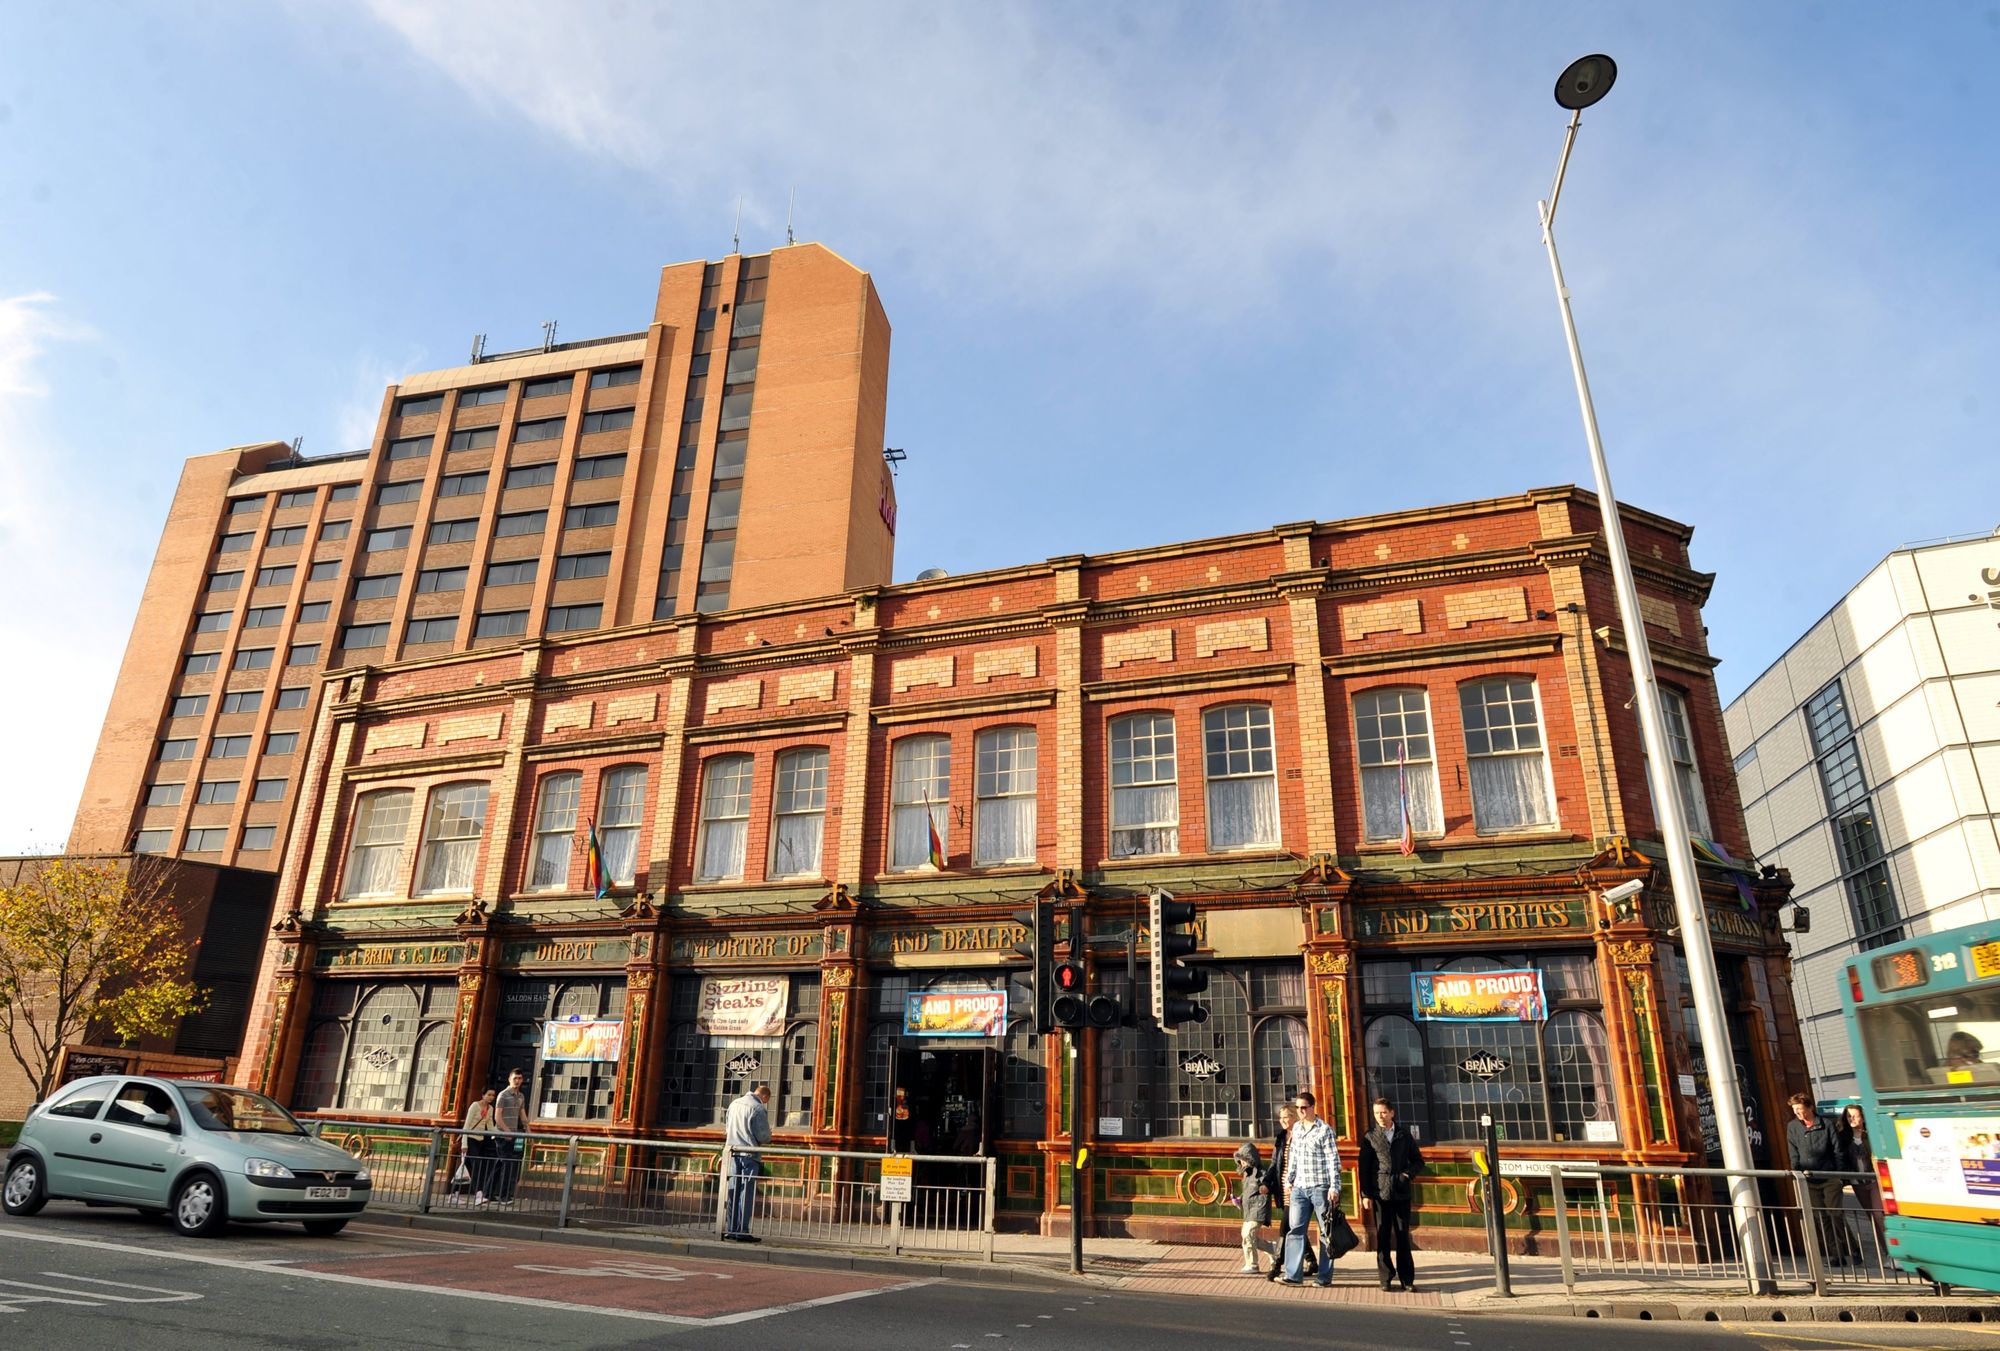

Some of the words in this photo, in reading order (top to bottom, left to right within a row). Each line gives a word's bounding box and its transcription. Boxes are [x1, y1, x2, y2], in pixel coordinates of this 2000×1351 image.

[1378, 908, 1430, 934] AND
[1451, 902, 1570, 931] SPIRITS
[535, 941, 598, 961] DIRECT
[681, 935, 777, 960] IMPORTER
[787, 935, 813, 956] OF
[889, 931, 929, 952] AND
[363, 948, 395, 965] BRAIN
[1931, 952, 1958, 972] 312
[704, 979, 780, 997] Sizzling
[1418, 978, 1432, 1005] WKD
[1437, 980, 1471, 998] AND
[1475, 976, 1538, 995] PROUD.
[507, 994, 533, 1002] SALOON
[704, 995, 765, 1011] Steaks
[925, 1000, 951, 1016] AND
[954, 997, 1002, 1013] PROUD.
[559, 1028, 580, 1041] AND
[1499, 1163, 1522, 1171] STOM
[1526, 1163, 1552, 1172] HOUS
